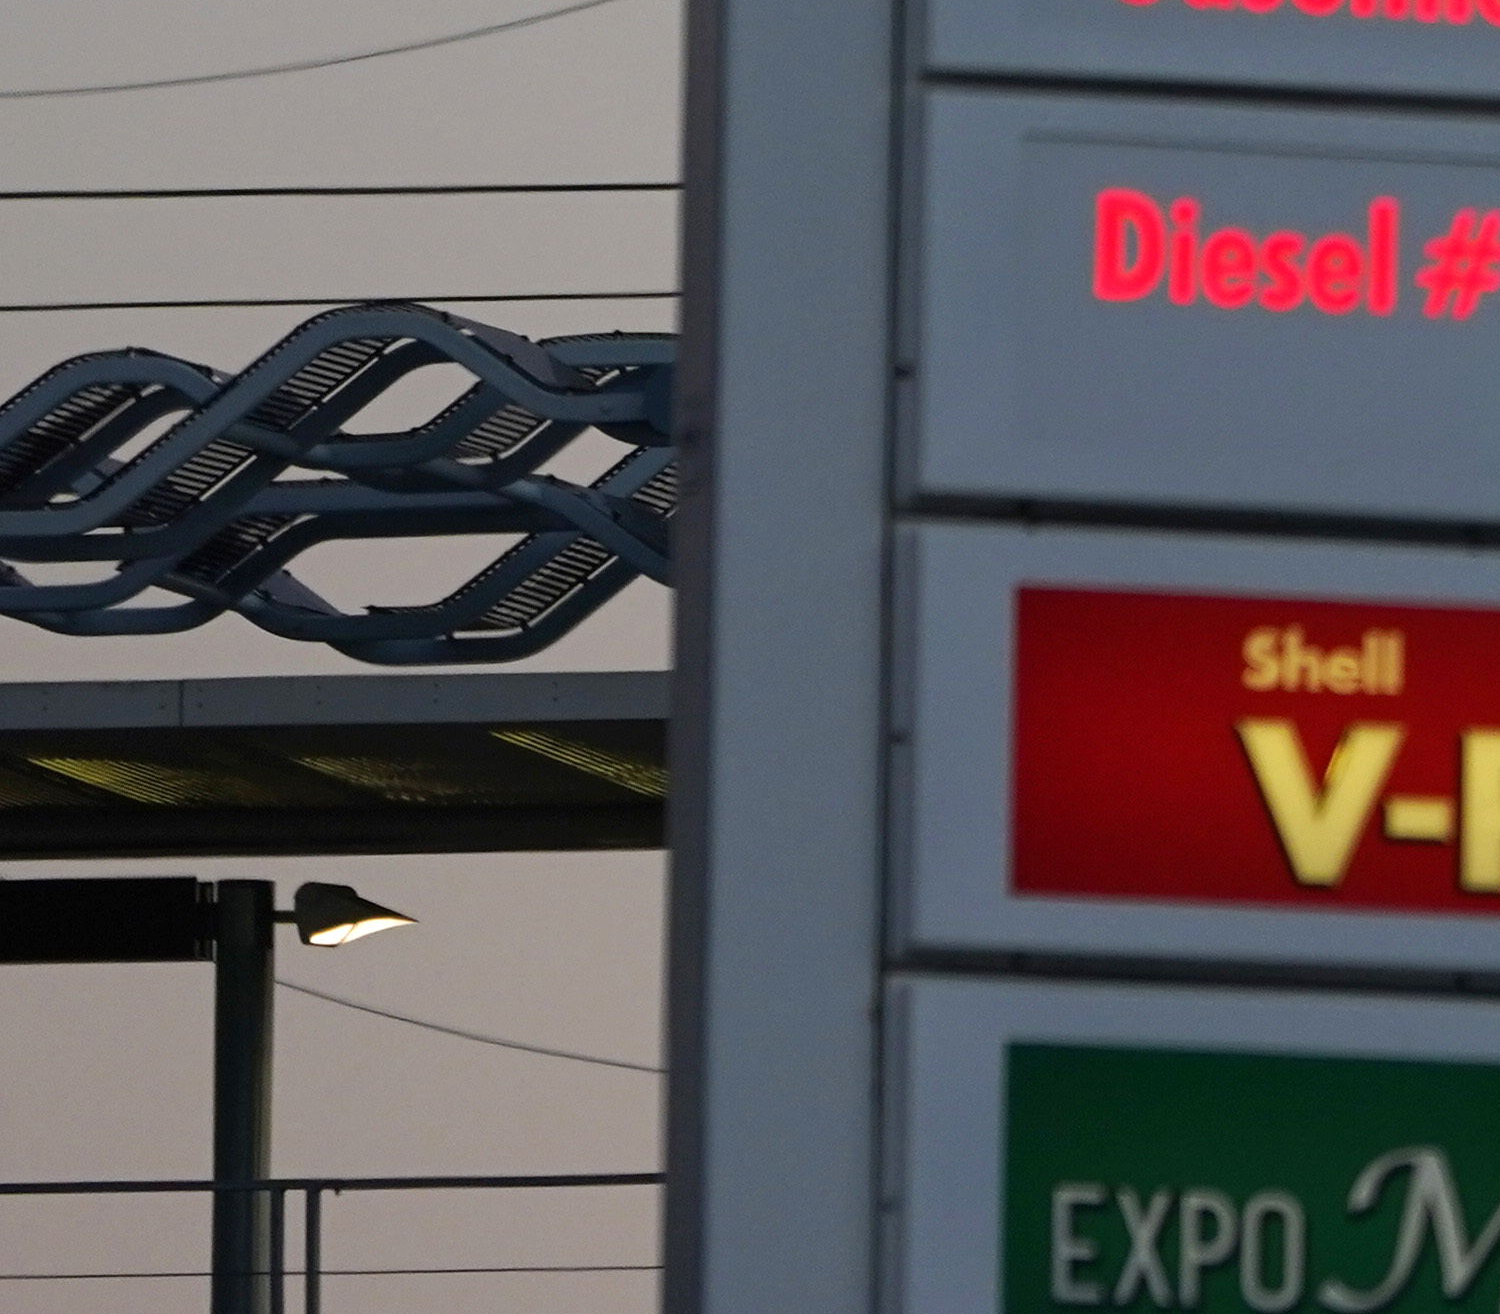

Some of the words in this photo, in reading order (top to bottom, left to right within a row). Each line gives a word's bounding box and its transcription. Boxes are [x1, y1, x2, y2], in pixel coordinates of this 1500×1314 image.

[1092, 187, 1400, 318] Diesel
[1240, 627, 1404, 696] Shell
[1051, 1181, 1307, 1314] EXPO
